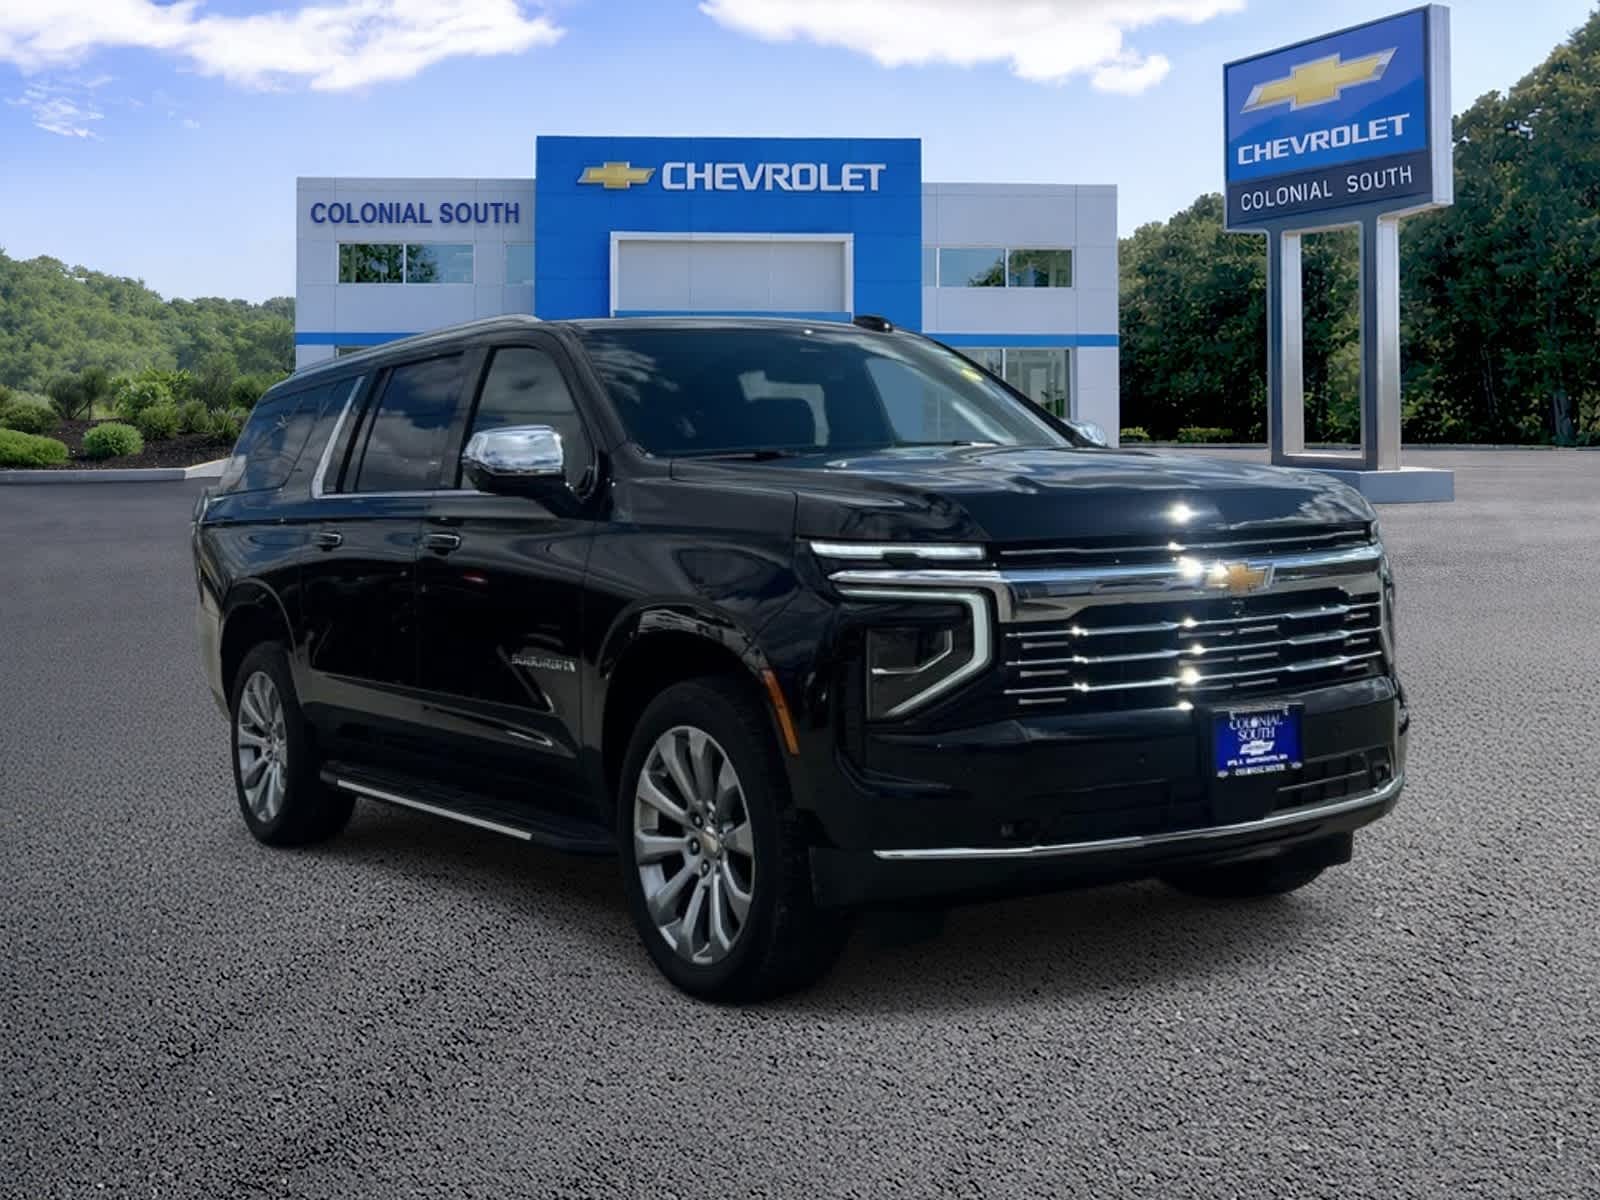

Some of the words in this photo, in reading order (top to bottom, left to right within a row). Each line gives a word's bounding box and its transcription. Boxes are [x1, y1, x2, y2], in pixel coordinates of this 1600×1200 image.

[1237, 113, 1410, 165] CHEVROLET
[662, 162, 887, 192] CHEVROLET
[1240, 180, 1333, 212] COLONIAL
[1346, 165, 1413, 194] SOUTH
[310, 202, 433, 224] COLONIAL
[439, 202, 520, 224] SOUTH
[1238, 727, 1275, 742] SOUTH
